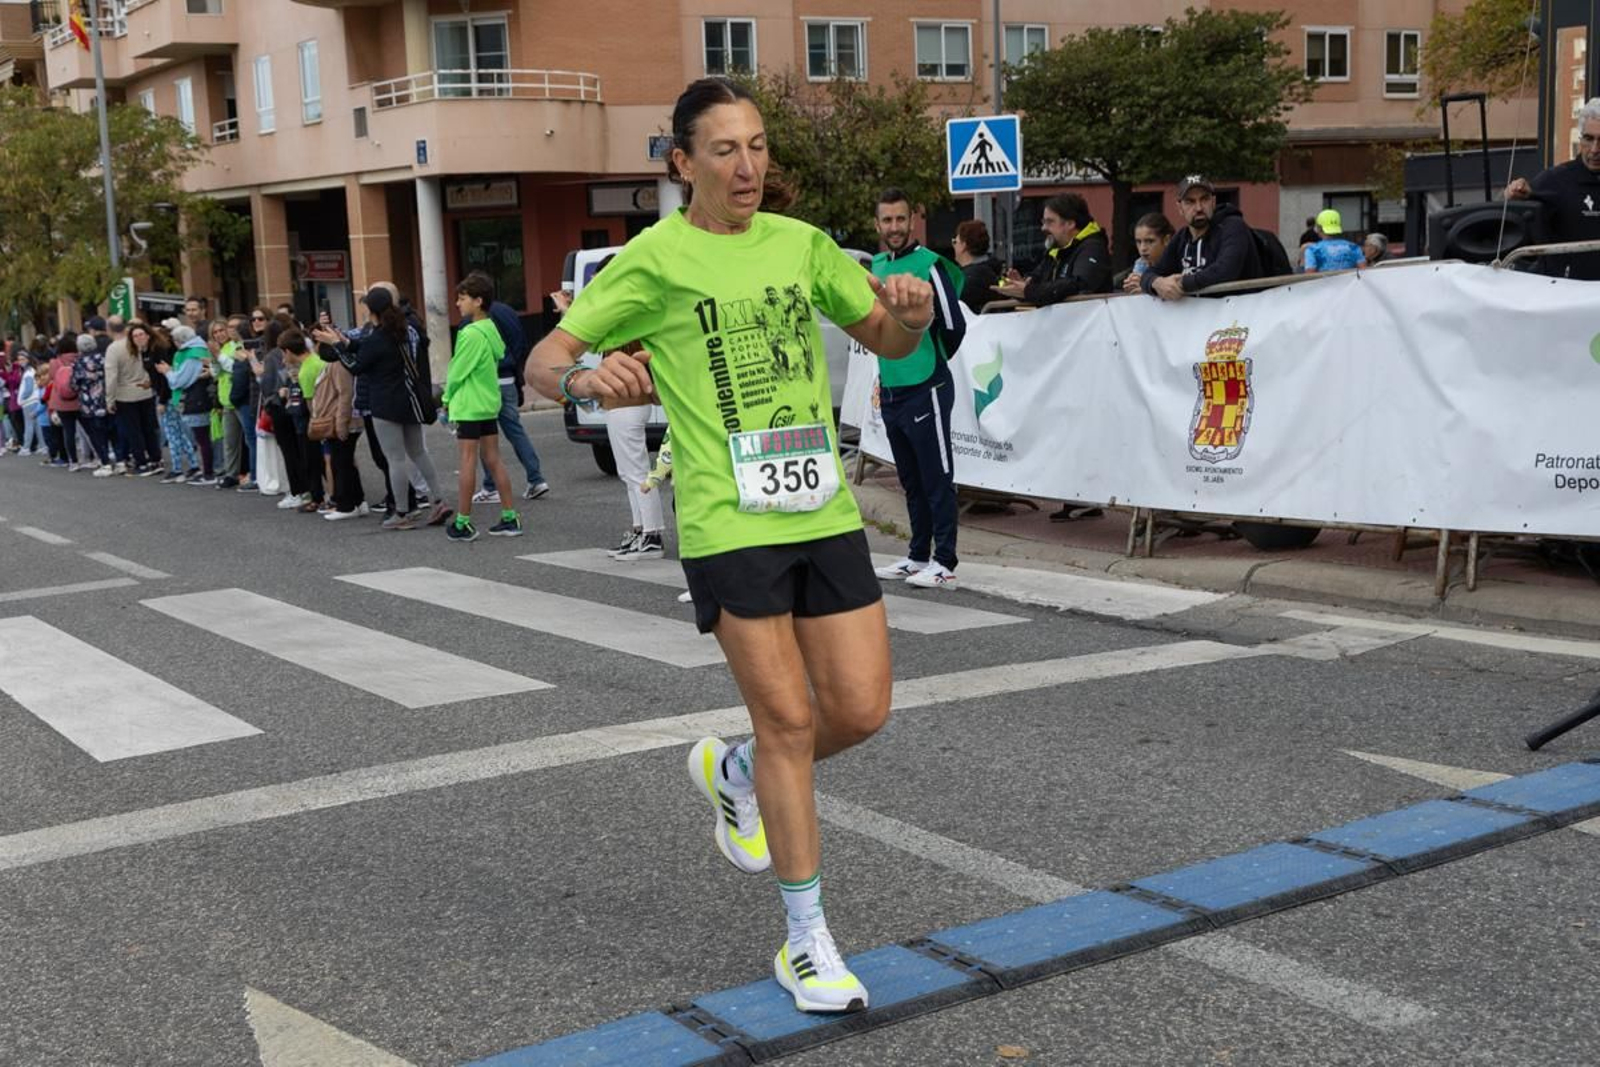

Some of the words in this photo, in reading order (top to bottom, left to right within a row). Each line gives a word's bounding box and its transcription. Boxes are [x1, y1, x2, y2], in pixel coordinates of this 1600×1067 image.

[694, 296, 719, 336] 17
[720, 298, 756, 330] XI
[759, 457, 820, 496] 356
